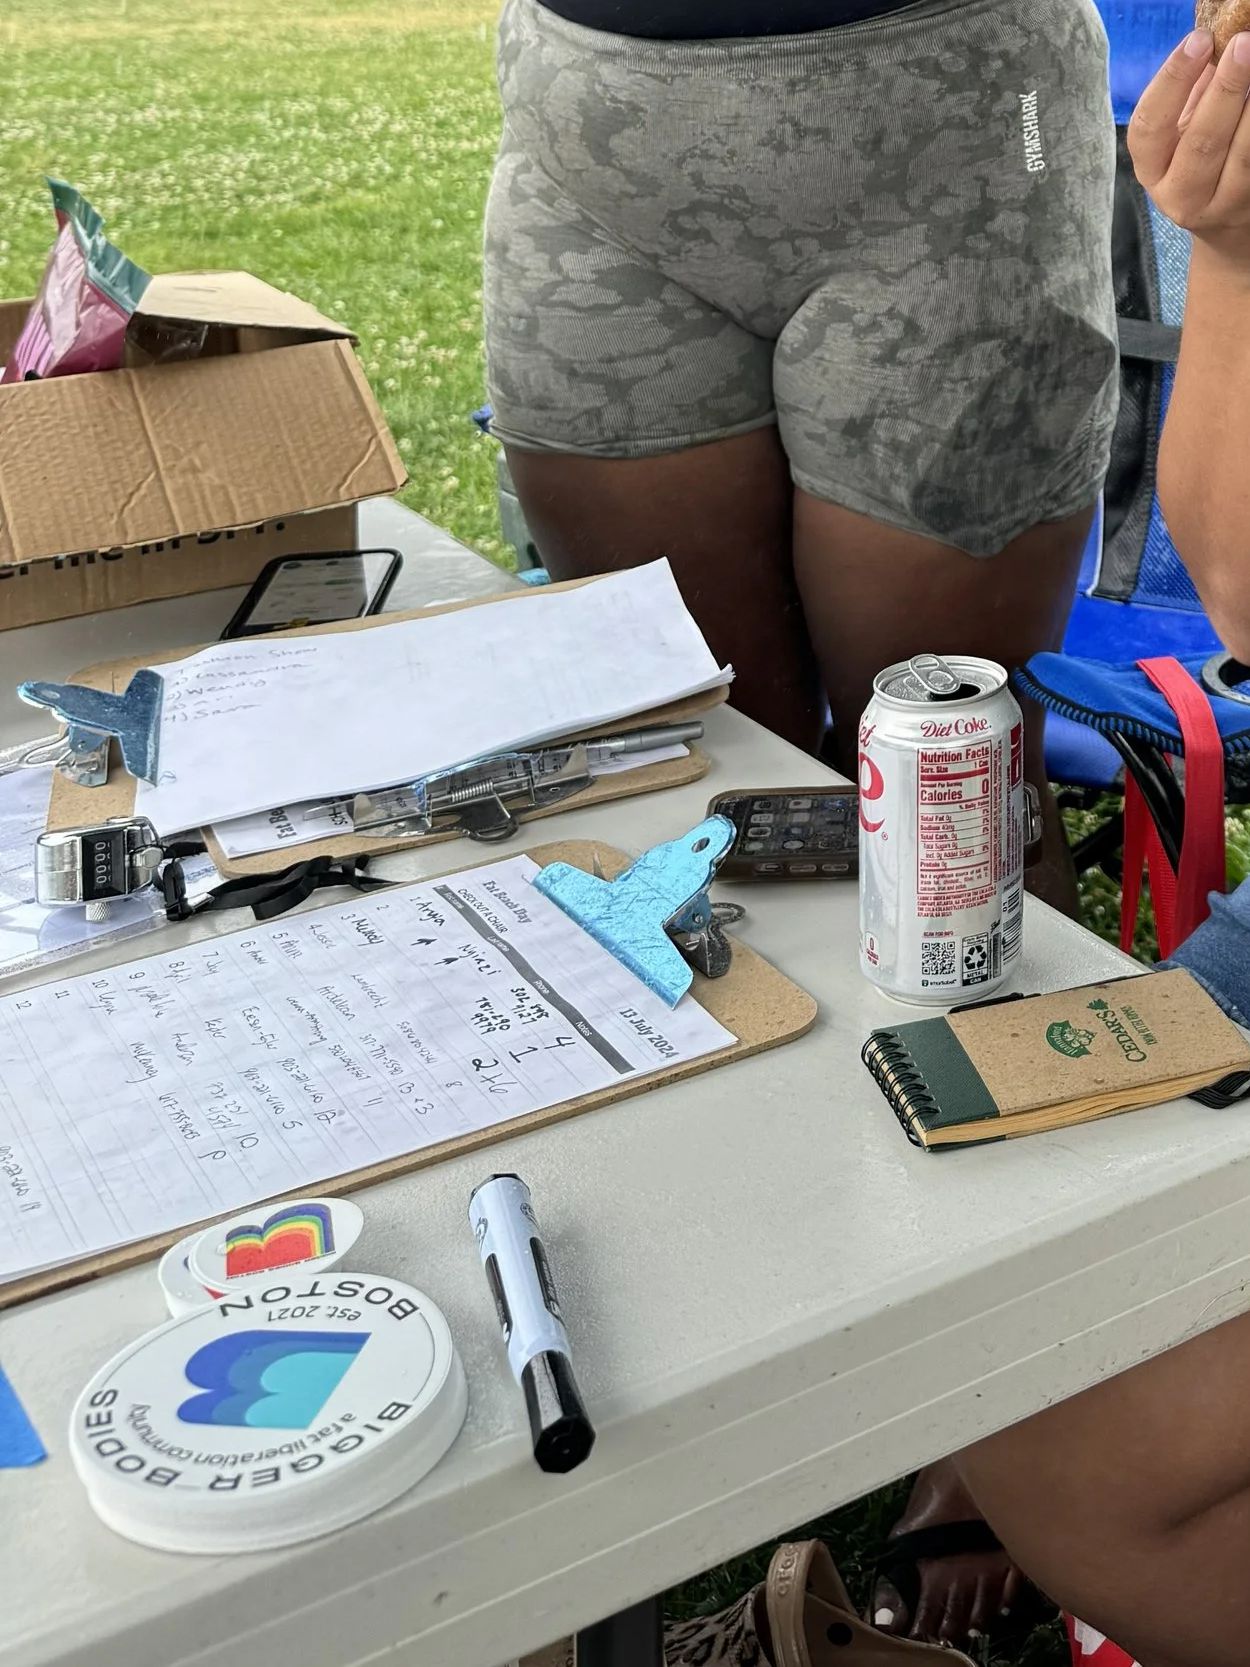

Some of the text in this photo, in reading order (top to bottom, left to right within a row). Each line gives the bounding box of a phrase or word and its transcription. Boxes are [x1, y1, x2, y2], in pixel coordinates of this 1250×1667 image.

[1019, 90, 1046, 173] GYMSHARK
[920, 720, 952, 738] Diet
[920, 745, 990, 763] Nutrition Facts
[920, 777, 990, 802] Calories 0
[482, 880, 532, 923] Fat Beach Day
[91, 979, 109, 988] 10
[128, 971, 146, 979] 9
[15, 1000, 32, 1009] 12
[54, 990, 70, 998] 11
[575, 1021, 593, 1036] Notes
[619, 1008, 679, 1058] 13 July 2024
[1095, 1009, 1148, 1063] CEDAR'S
[217, 1280, 421, 1321] BOSTON
[267, 1305, 363, 1322] est. 2021
[85, 1387, 413, 1491] BIGGER BODIES
[128, 1402, 194, 1464] community
[310, 1420, 344, 1445] fat
[196, 1438, 309, 1466] liberation
